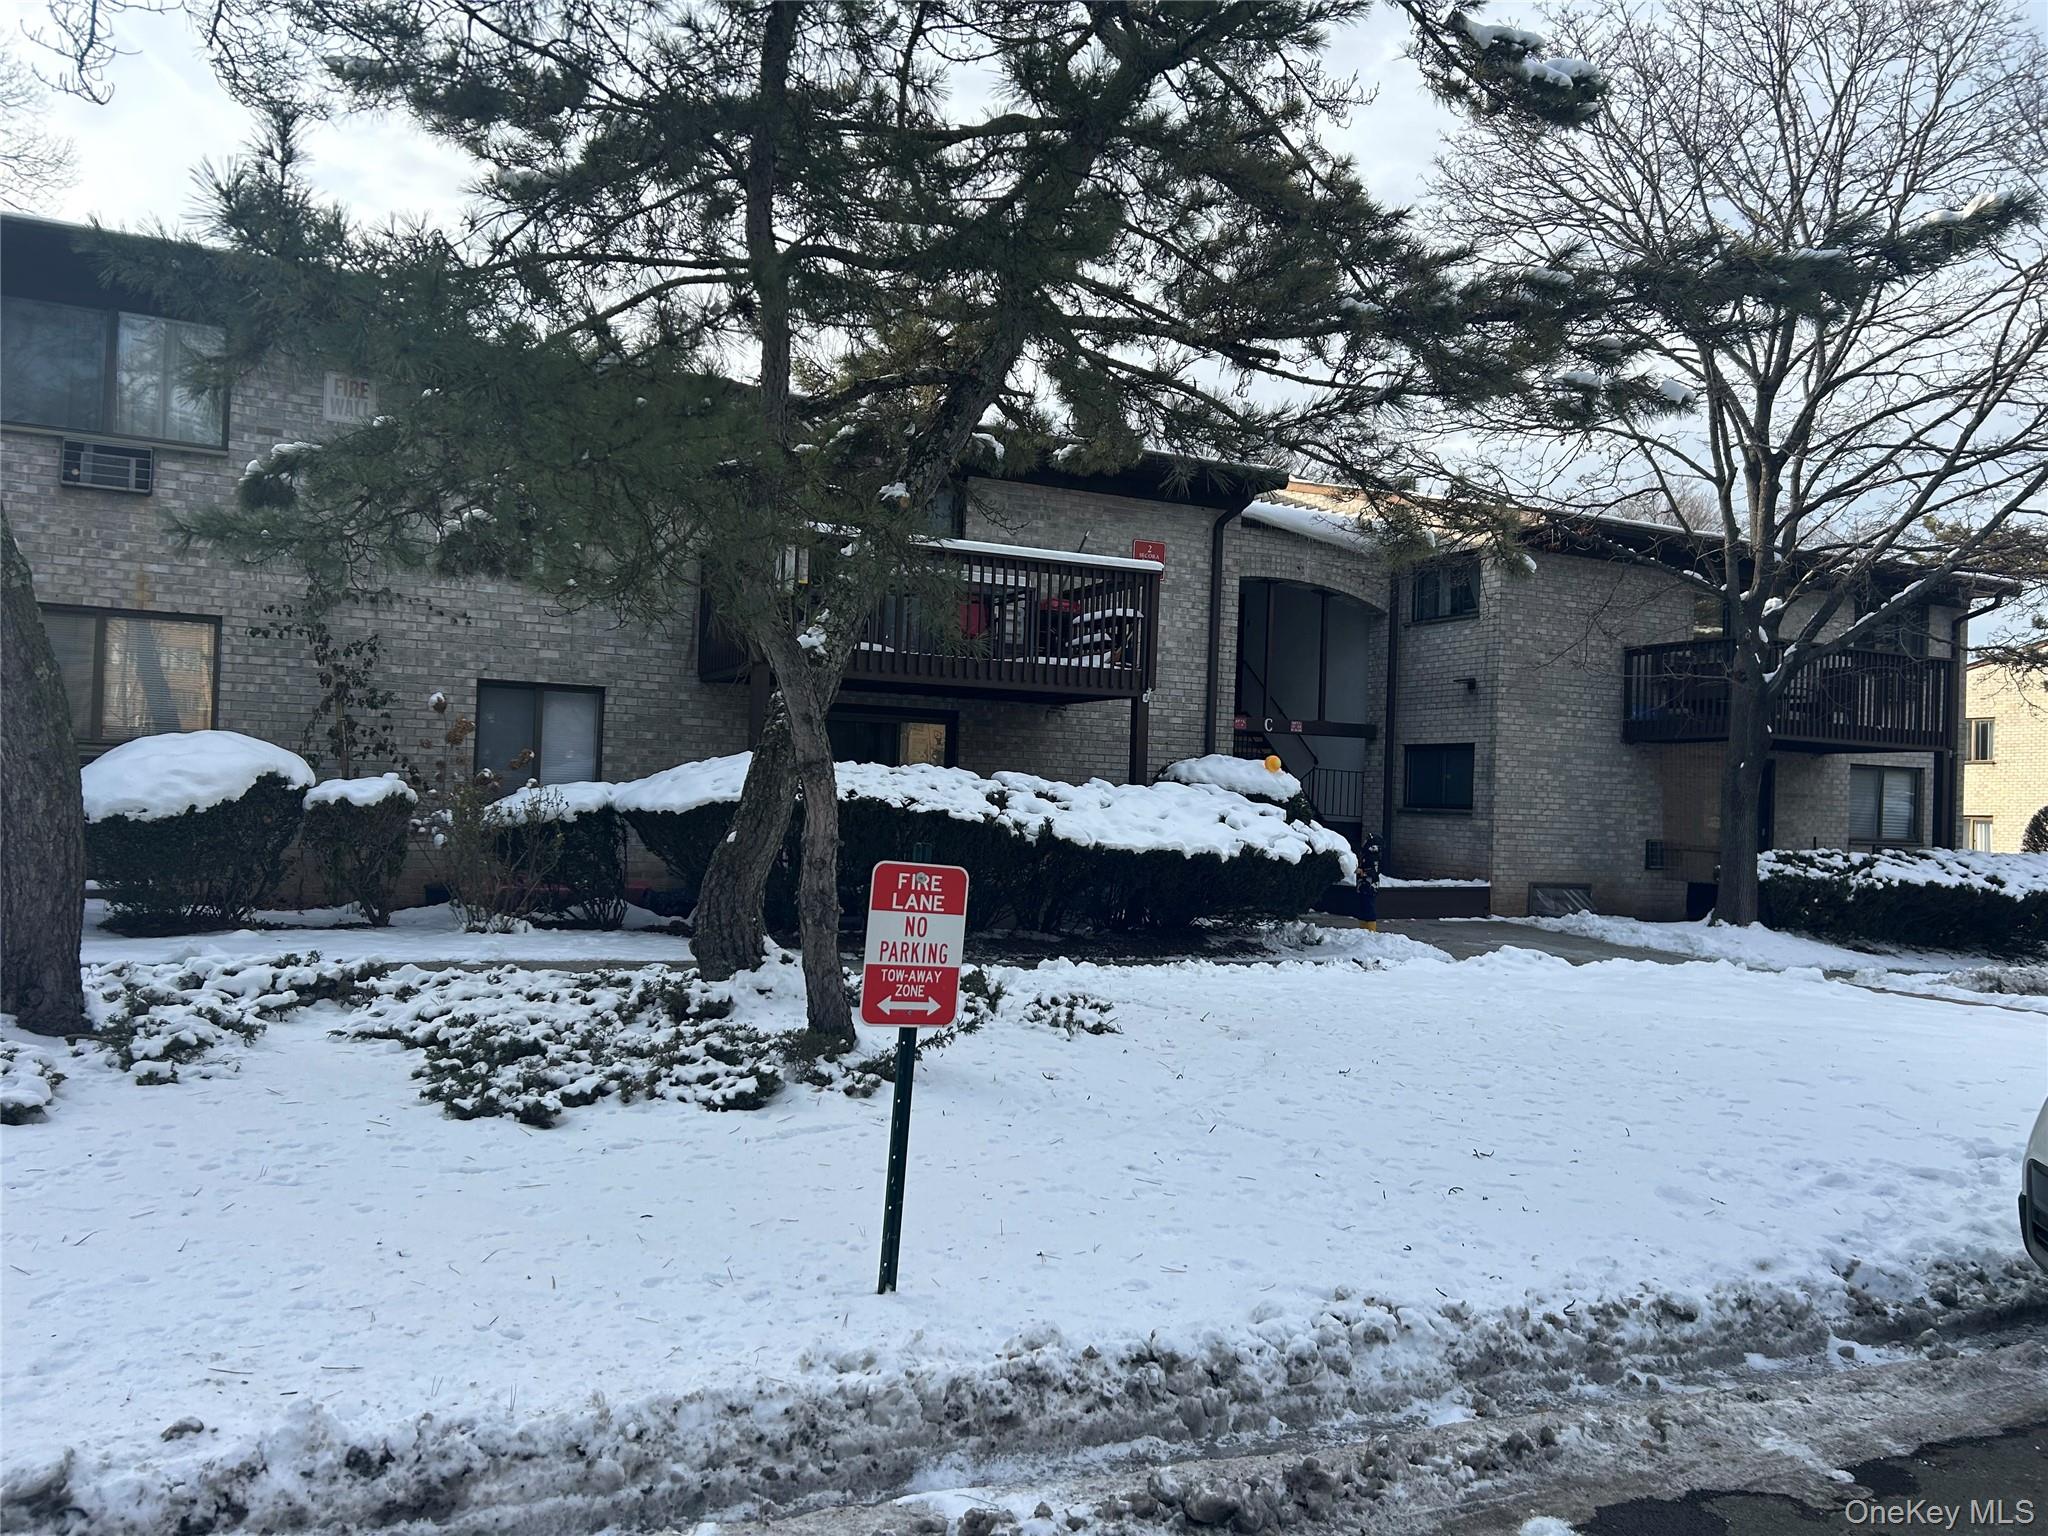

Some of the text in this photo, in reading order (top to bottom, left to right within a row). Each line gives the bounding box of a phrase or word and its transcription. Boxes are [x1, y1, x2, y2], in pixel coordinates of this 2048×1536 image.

[335, 379, 369, 399] FIRE
[1147, 544, 1153, 553] 2
[1264, 718, 1273, 732] C
[898, 872, 943, 892] FIRE
[892, 893, 945, 912] LANE
[904, 915, 928, 937] NO
[879, 940, 948, 964] PARKING
[881, 968, 943, 983] TOW-AWAY
[895, 984, 925, 998] ZONE
